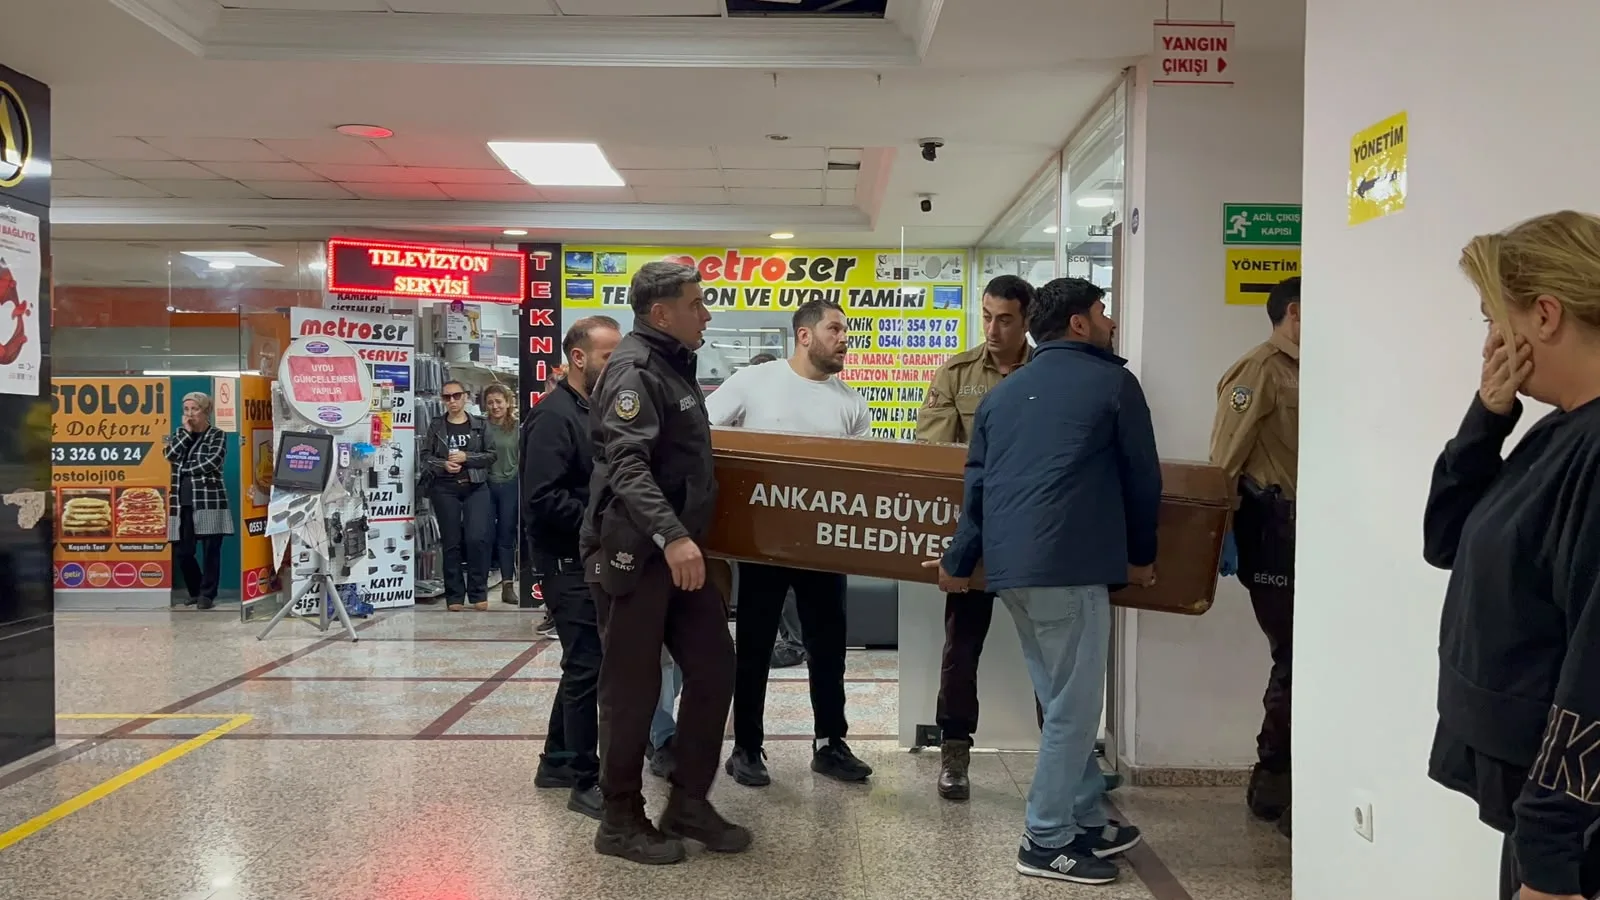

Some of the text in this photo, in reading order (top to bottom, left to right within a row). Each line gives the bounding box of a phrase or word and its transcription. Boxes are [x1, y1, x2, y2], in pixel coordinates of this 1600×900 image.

[1162, 37, 1228, 51] YANGIN
[1162, 57, 1208, 77] ÇIKIŞI
[1353, 125, 1405, 163] YÖNETİM
[1252, 212, 1275, 222] ACİL
[368, 248, 489, 273] TELEVİZYON
[1231, 257, 1298, 272] YÖNETİM
[393, 276, 470, 296] SERVİSİ
[744, 287, 771, 308] VE
[300, 316, 409, 341] metroser
[907, 319, 926, 332] 354
[930, 320, 942, 332] 97
[945, 320, 958, 332] 67
[907, 336, 925, 348] 838
[929, 336, 941, 348] 84
[945, 336, 958, 348] 83
[862, 354, 894, 365] MARKA
[311, 363, 335, 372] UYDU
[311, 387, 343, 395] YAPILIR
[69, 447, 97, 461] 326
[100, 447, 119, 461] 06
[123, 447, 141, 461] 24
[749, 483, 869, 518] ANKARA
[370, 577, 404, 590] KAYIT
